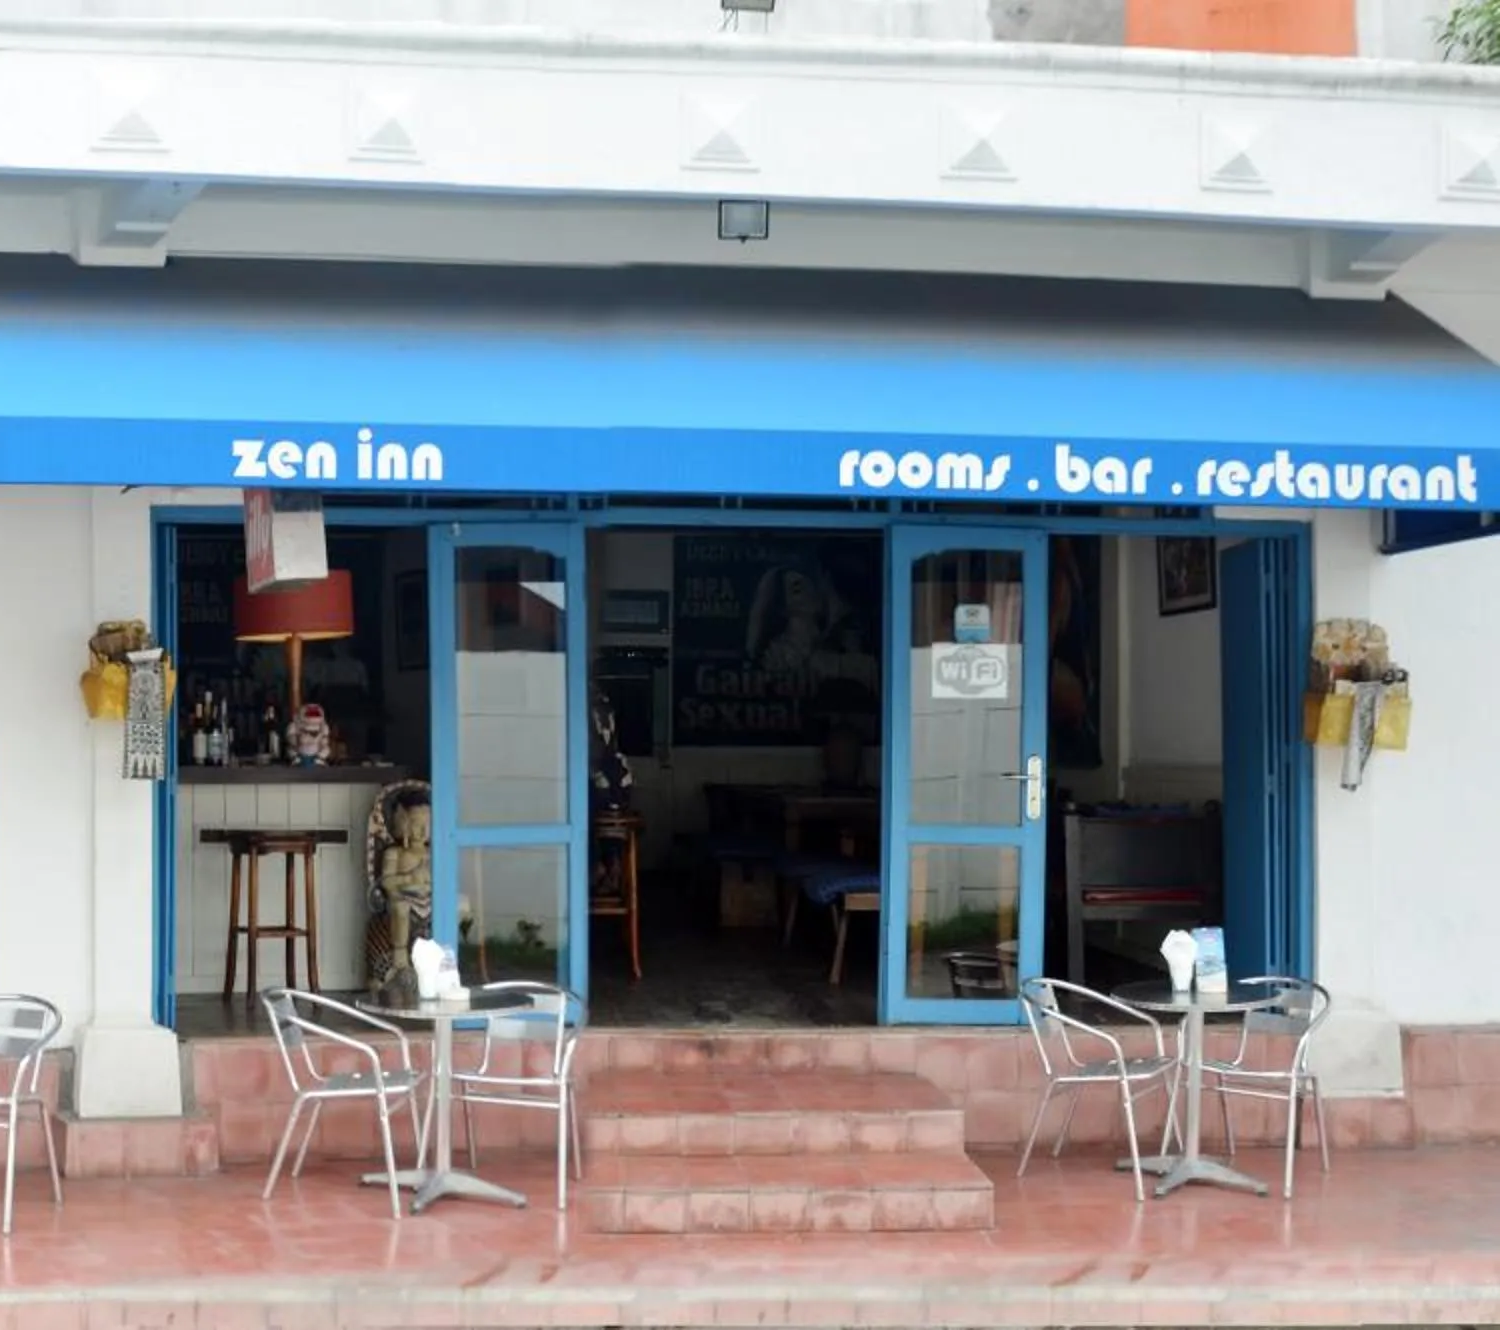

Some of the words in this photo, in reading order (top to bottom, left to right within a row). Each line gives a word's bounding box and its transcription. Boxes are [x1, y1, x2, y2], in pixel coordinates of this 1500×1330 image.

[231, 438, 338, 481] zen
[356, 426, 444, 482] inn
[838, 449, 1012, 492] rooms
[1054, 443, 1154, 495] bar
[1195, 449, 1478, 503] restaurant
